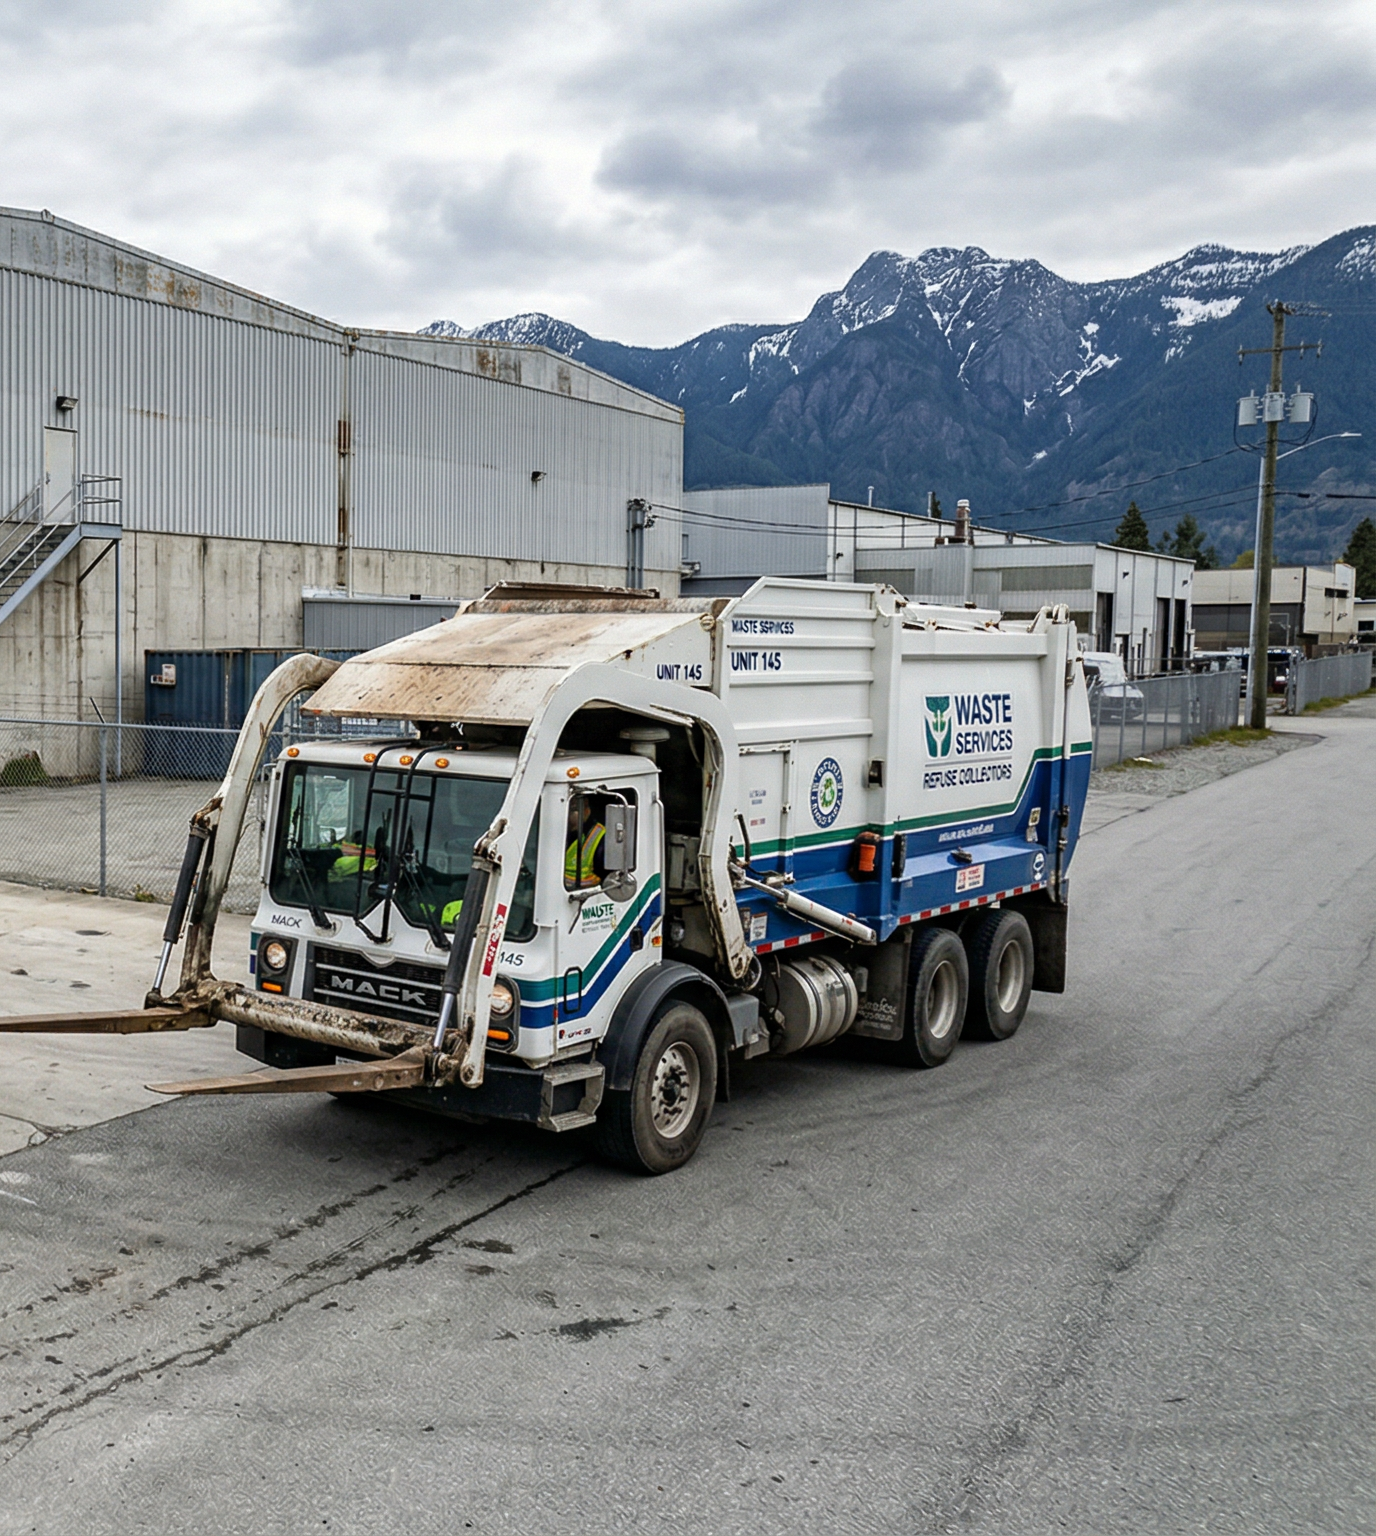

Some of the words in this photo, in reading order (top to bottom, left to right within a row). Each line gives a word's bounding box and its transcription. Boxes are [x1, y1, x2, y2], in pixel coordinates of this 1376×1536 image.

[657, 664, 680, 680] UNIT
[684, 664, 702, 680] 145
[731, 652, 759, 671] UNIT
[762, 652, 781, 671] 145
[954, 693, 1012, 725] WASTE
[956, 729, 1013, 755] SERVICES
[500, 951, 525, 966] 145
[331, 975, 427, 1006] MACK
